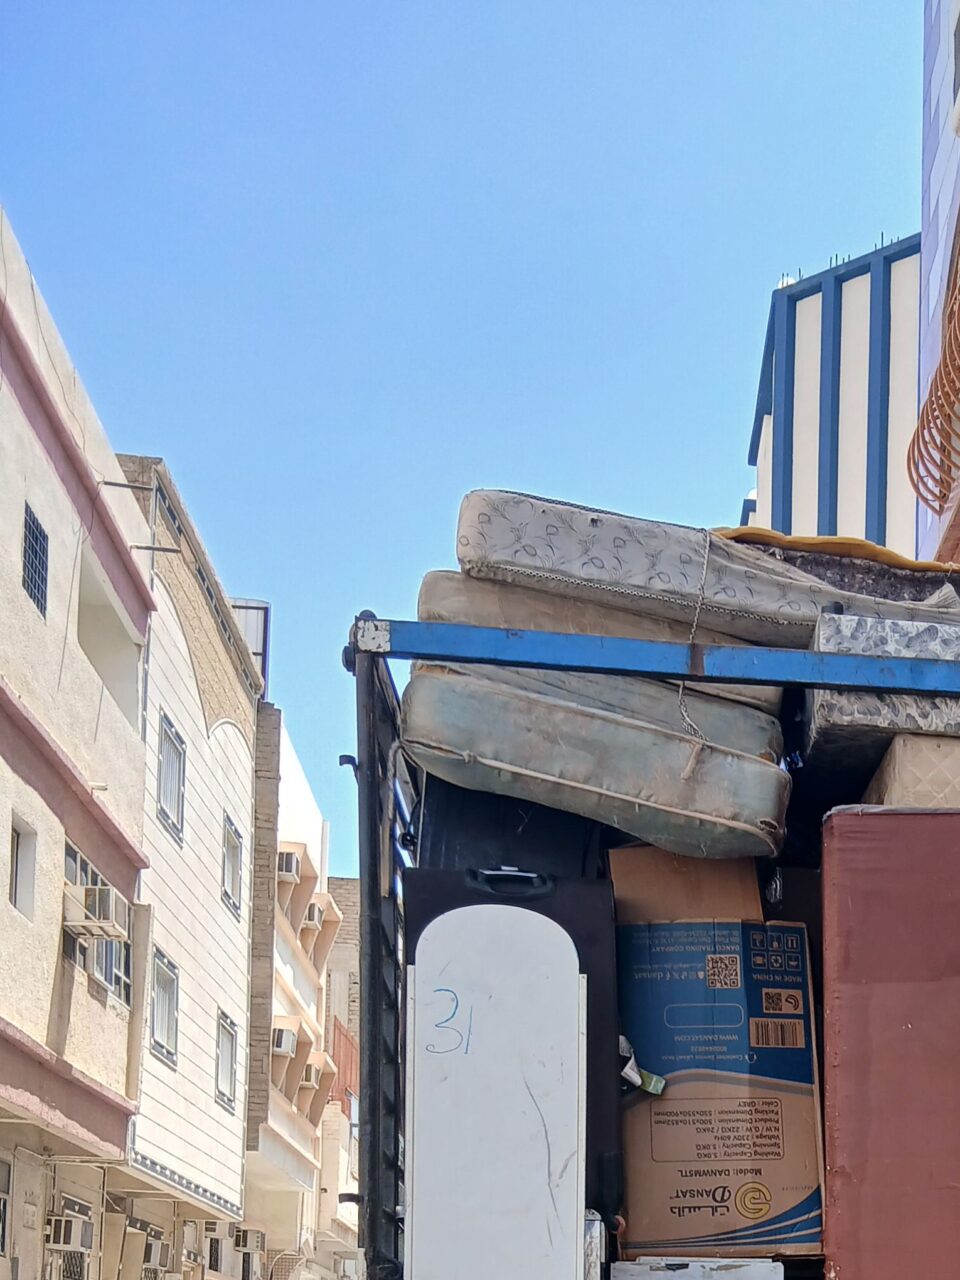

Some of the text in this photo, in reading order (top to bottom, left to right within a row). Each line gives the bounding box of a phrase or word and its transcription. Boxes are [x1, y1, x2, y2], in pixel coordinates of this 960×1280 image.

[752, 973, 773, 981] CHINA
[754, 1108, 779, 1116] Packing
[722, 1142, 752, 1150] Capacity
[723, 1150, 752, 1158] Capacity
[753, 1150, 782, 1158] Washing
[732, 1168, 762, 1177] Model:
[674, 1185, 732, 1204] DANSAT
[670, 1205, 730, 1217] دانسات
